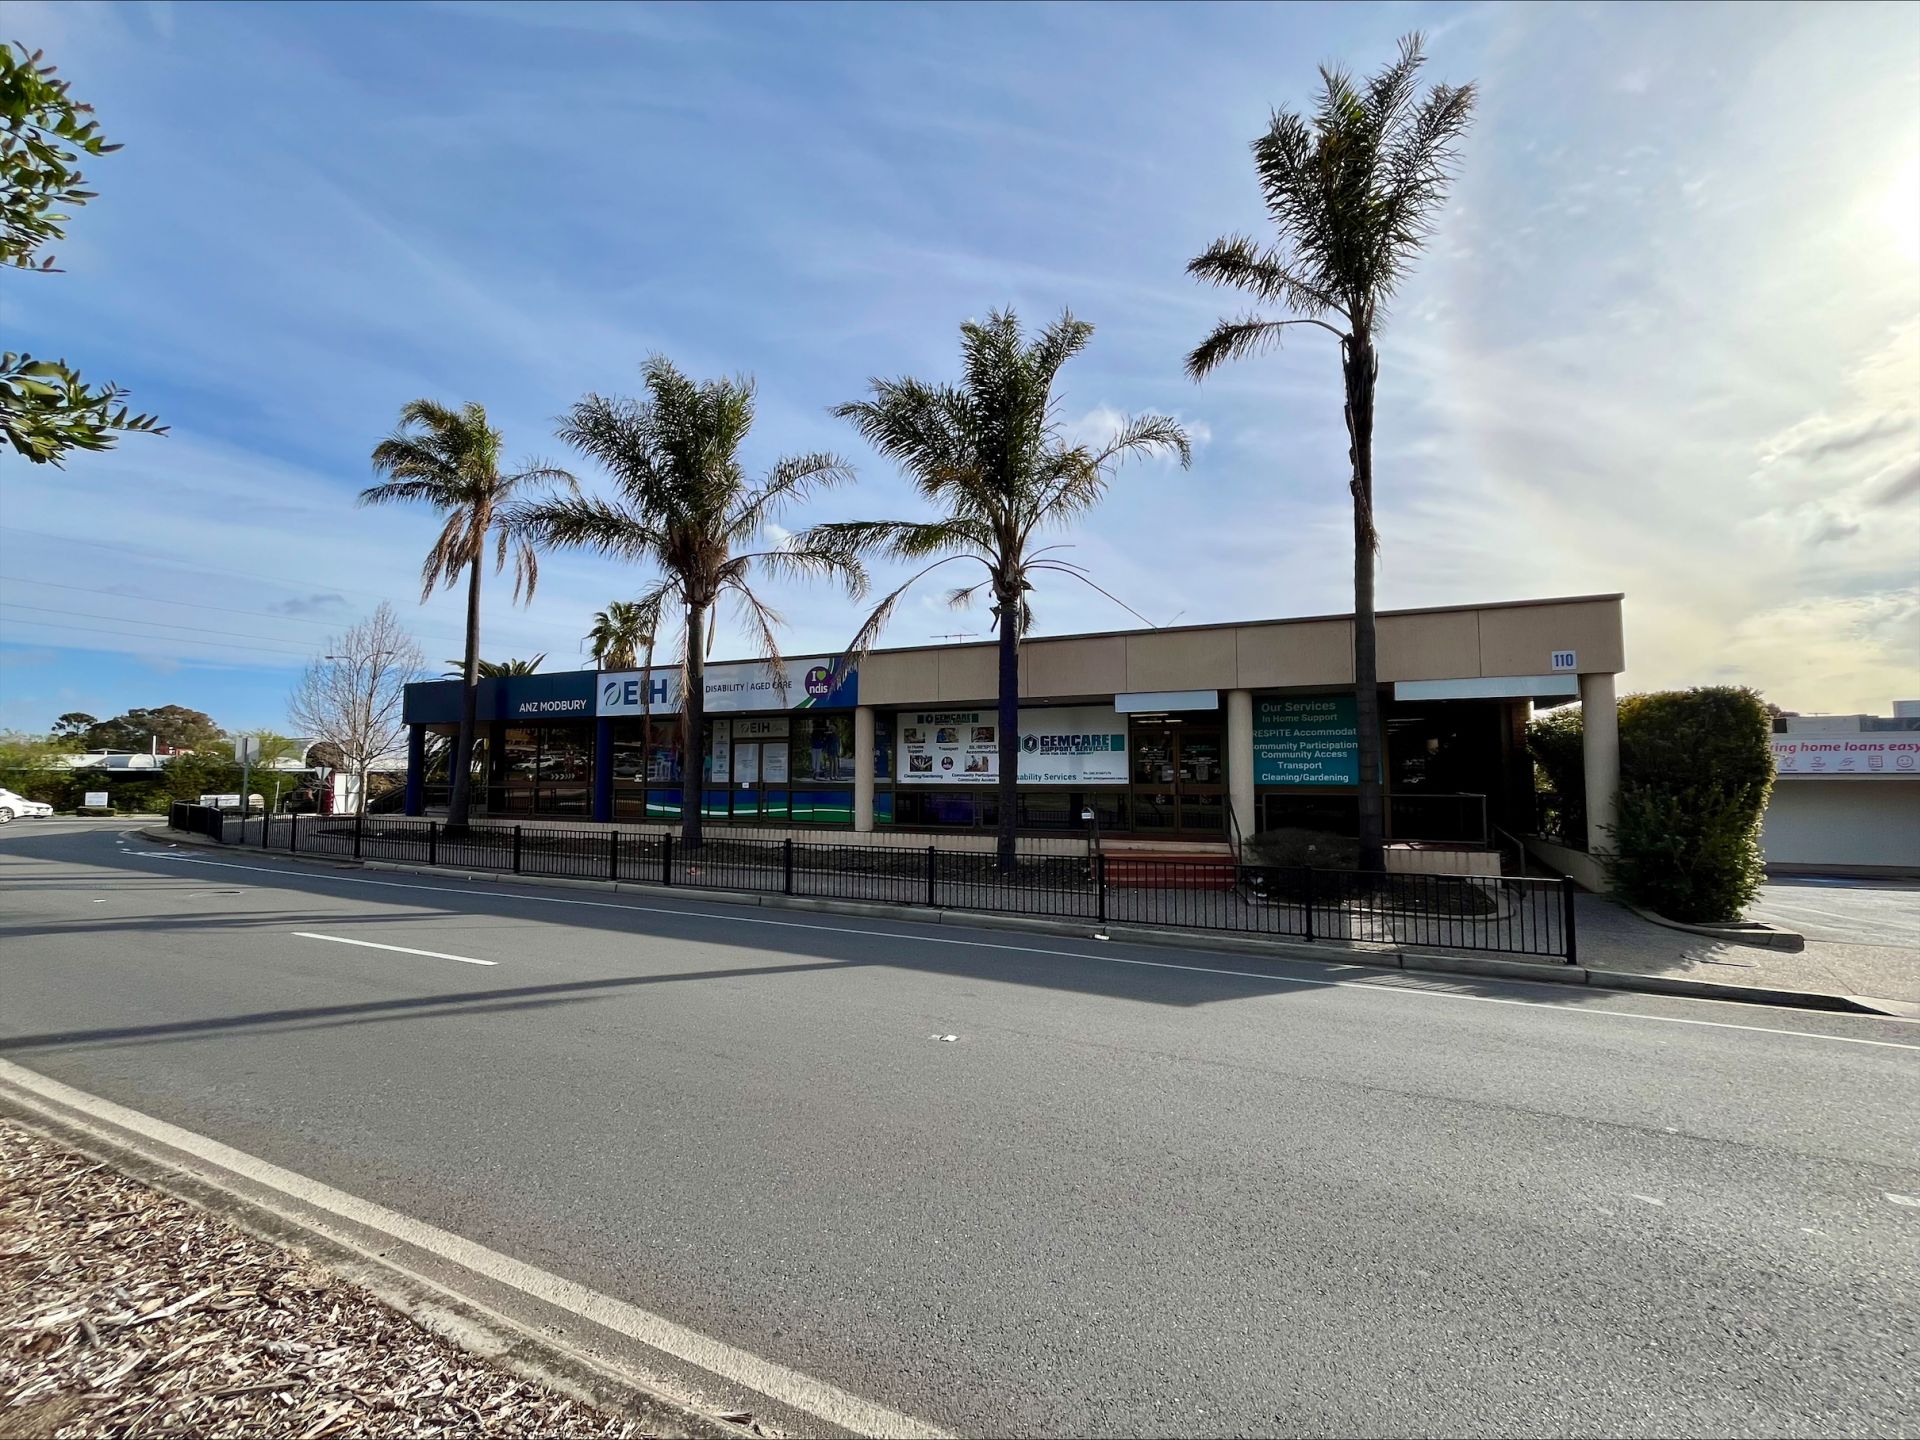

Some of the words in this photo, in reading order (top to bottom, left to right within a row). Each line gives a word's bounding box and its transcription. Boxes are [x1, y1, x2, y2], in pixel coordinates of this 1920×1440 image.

[1554, 653, 1574, 667] 110
[624, 679, 667, 705] EH
[705, 683, 745, 693] DISABILITY
[750, 681, 770, 690] AGED
[809, 683, 829, 694] ndis
[519, 702, 538, 713] ANZ
[540, 699, 587, 711] MODBURY
[1261, 703, 1282, 713] Our
[1285, 701, 1336, 711] Services
[1301, 714, 1338, 722] Support
[750, 722, 770, 733] EIH
[1293, 728, 1357, 737] Accommodat
[1040, 735, 1110, 746] GEMCARE
[1253, 742, 1298, 751] ommunity
[1299, 741, 1359, 751] Participation
[1800, 743, 1841, 752] home
[1845, 742, 1885, 752] loans
[1261, 751, 1312, 760] Community
[1314, 750, 1348, 758] Access
[1277, 761, 1323, 771] Transport
[1044, 773, 1077, 781] Services
[1262, 773, 1349, 783] Cleaning/Gardening
